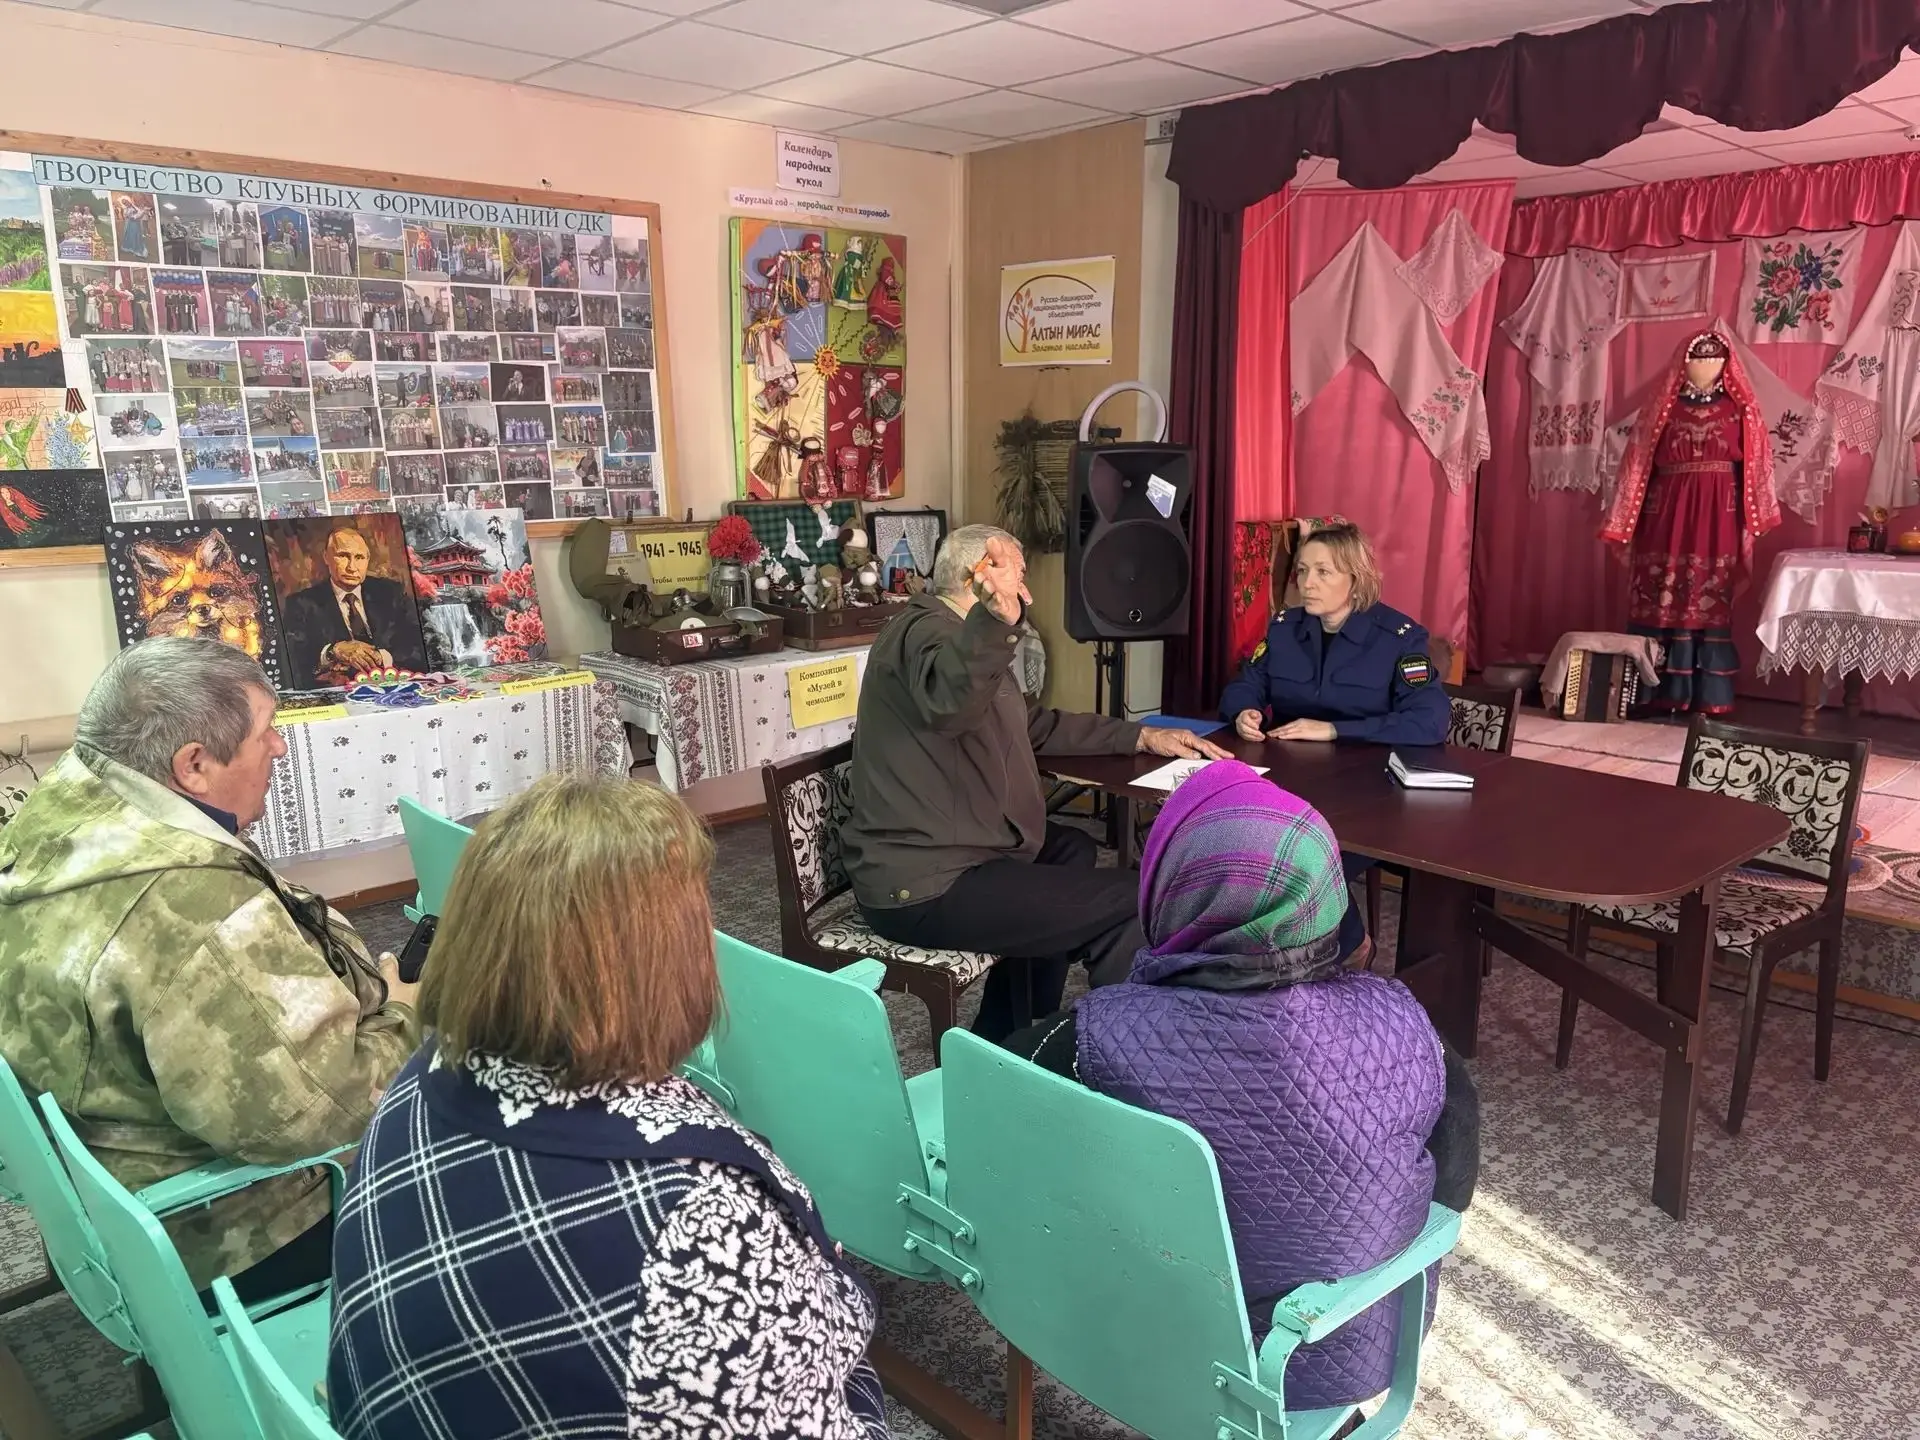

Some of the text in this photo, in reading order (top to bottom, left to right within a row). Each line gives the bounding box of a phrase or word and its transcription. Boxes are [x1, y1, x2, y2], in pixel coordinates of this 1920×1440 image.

[784, 140, 832, 160] Календарь
[785, 158, 832, 174] народных
[796, 177, 823, 188] кукол
[35, 159, 604, 233] ТВОРЧЕСТВО КЛУБНЫХ ФОРМИРОВАНИЙ СДК
[734, 194, 773, 206] «Круглый
[775, 197, 788, 207] год
[797, 199, 833, 212] народных
[858, 208, 891, 219] хоровод»
[1031, 323, 1101, 341] АЛТЫН МИРАС
[1065, 340, 1100, 351] наследие
[640, 543, 665, 558] 1941
[677, 541, 702, 556] 1945
[799, 665, 848, 681] Композиция
[807, 680, 836, 692] «Музей
[805, 692, 845, 706] чемодане»
